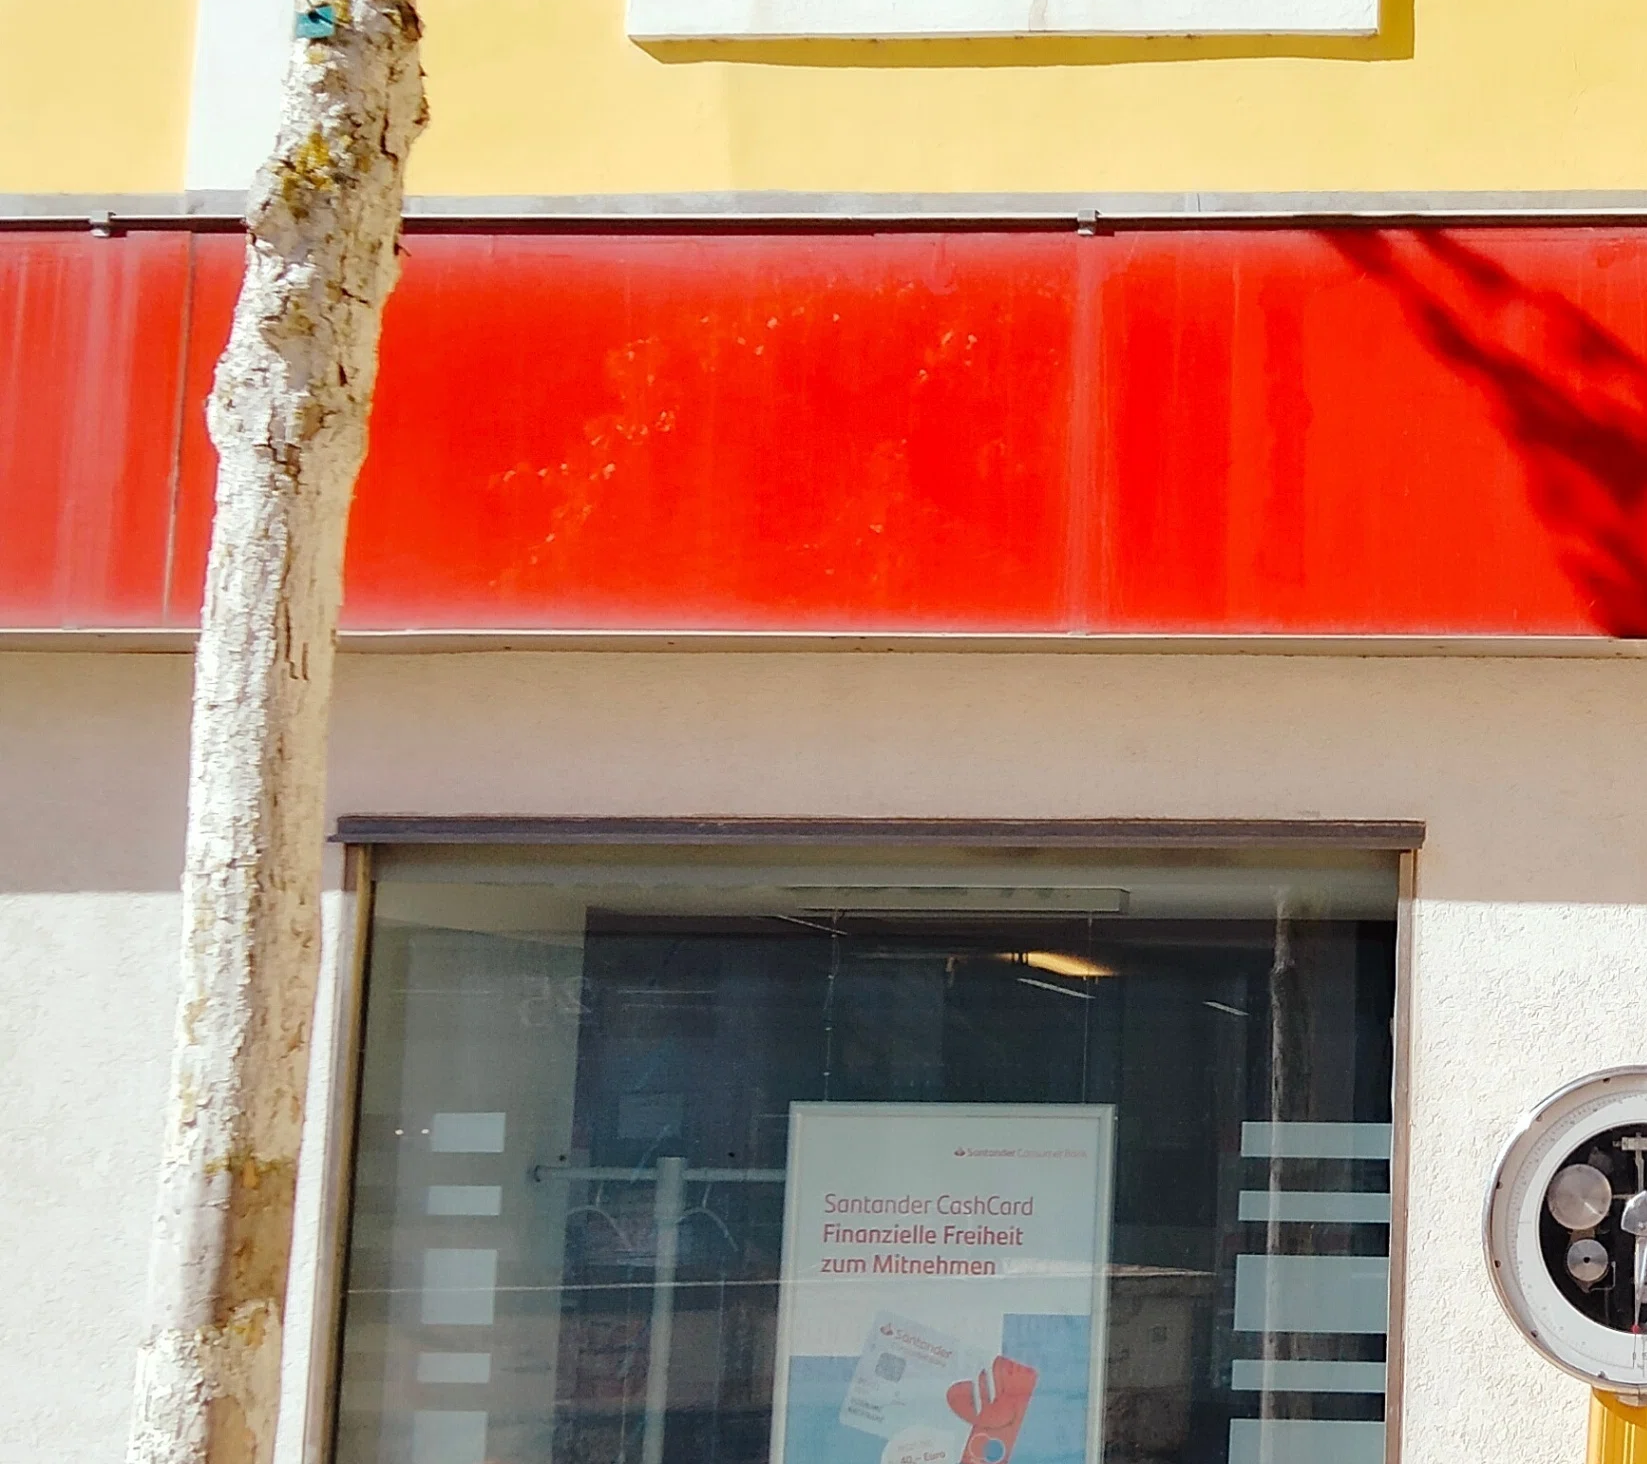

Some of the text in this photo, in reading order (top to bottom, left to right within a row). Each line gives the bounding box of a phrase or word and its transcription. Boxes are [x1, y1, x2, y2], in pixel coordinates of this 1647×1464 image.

[967, 1147, 1016, 1158] Santander
[824, 1193, 1034, 1216] Santander CashCard
[823, 1223, 1024, 1246] Finanzielle Freiheit
[820, 1253, 996, 1276] zum Mitnehmen
[894, 1329, 952, 1359] Santander
[923, 1451, 946, 1462] Euro
